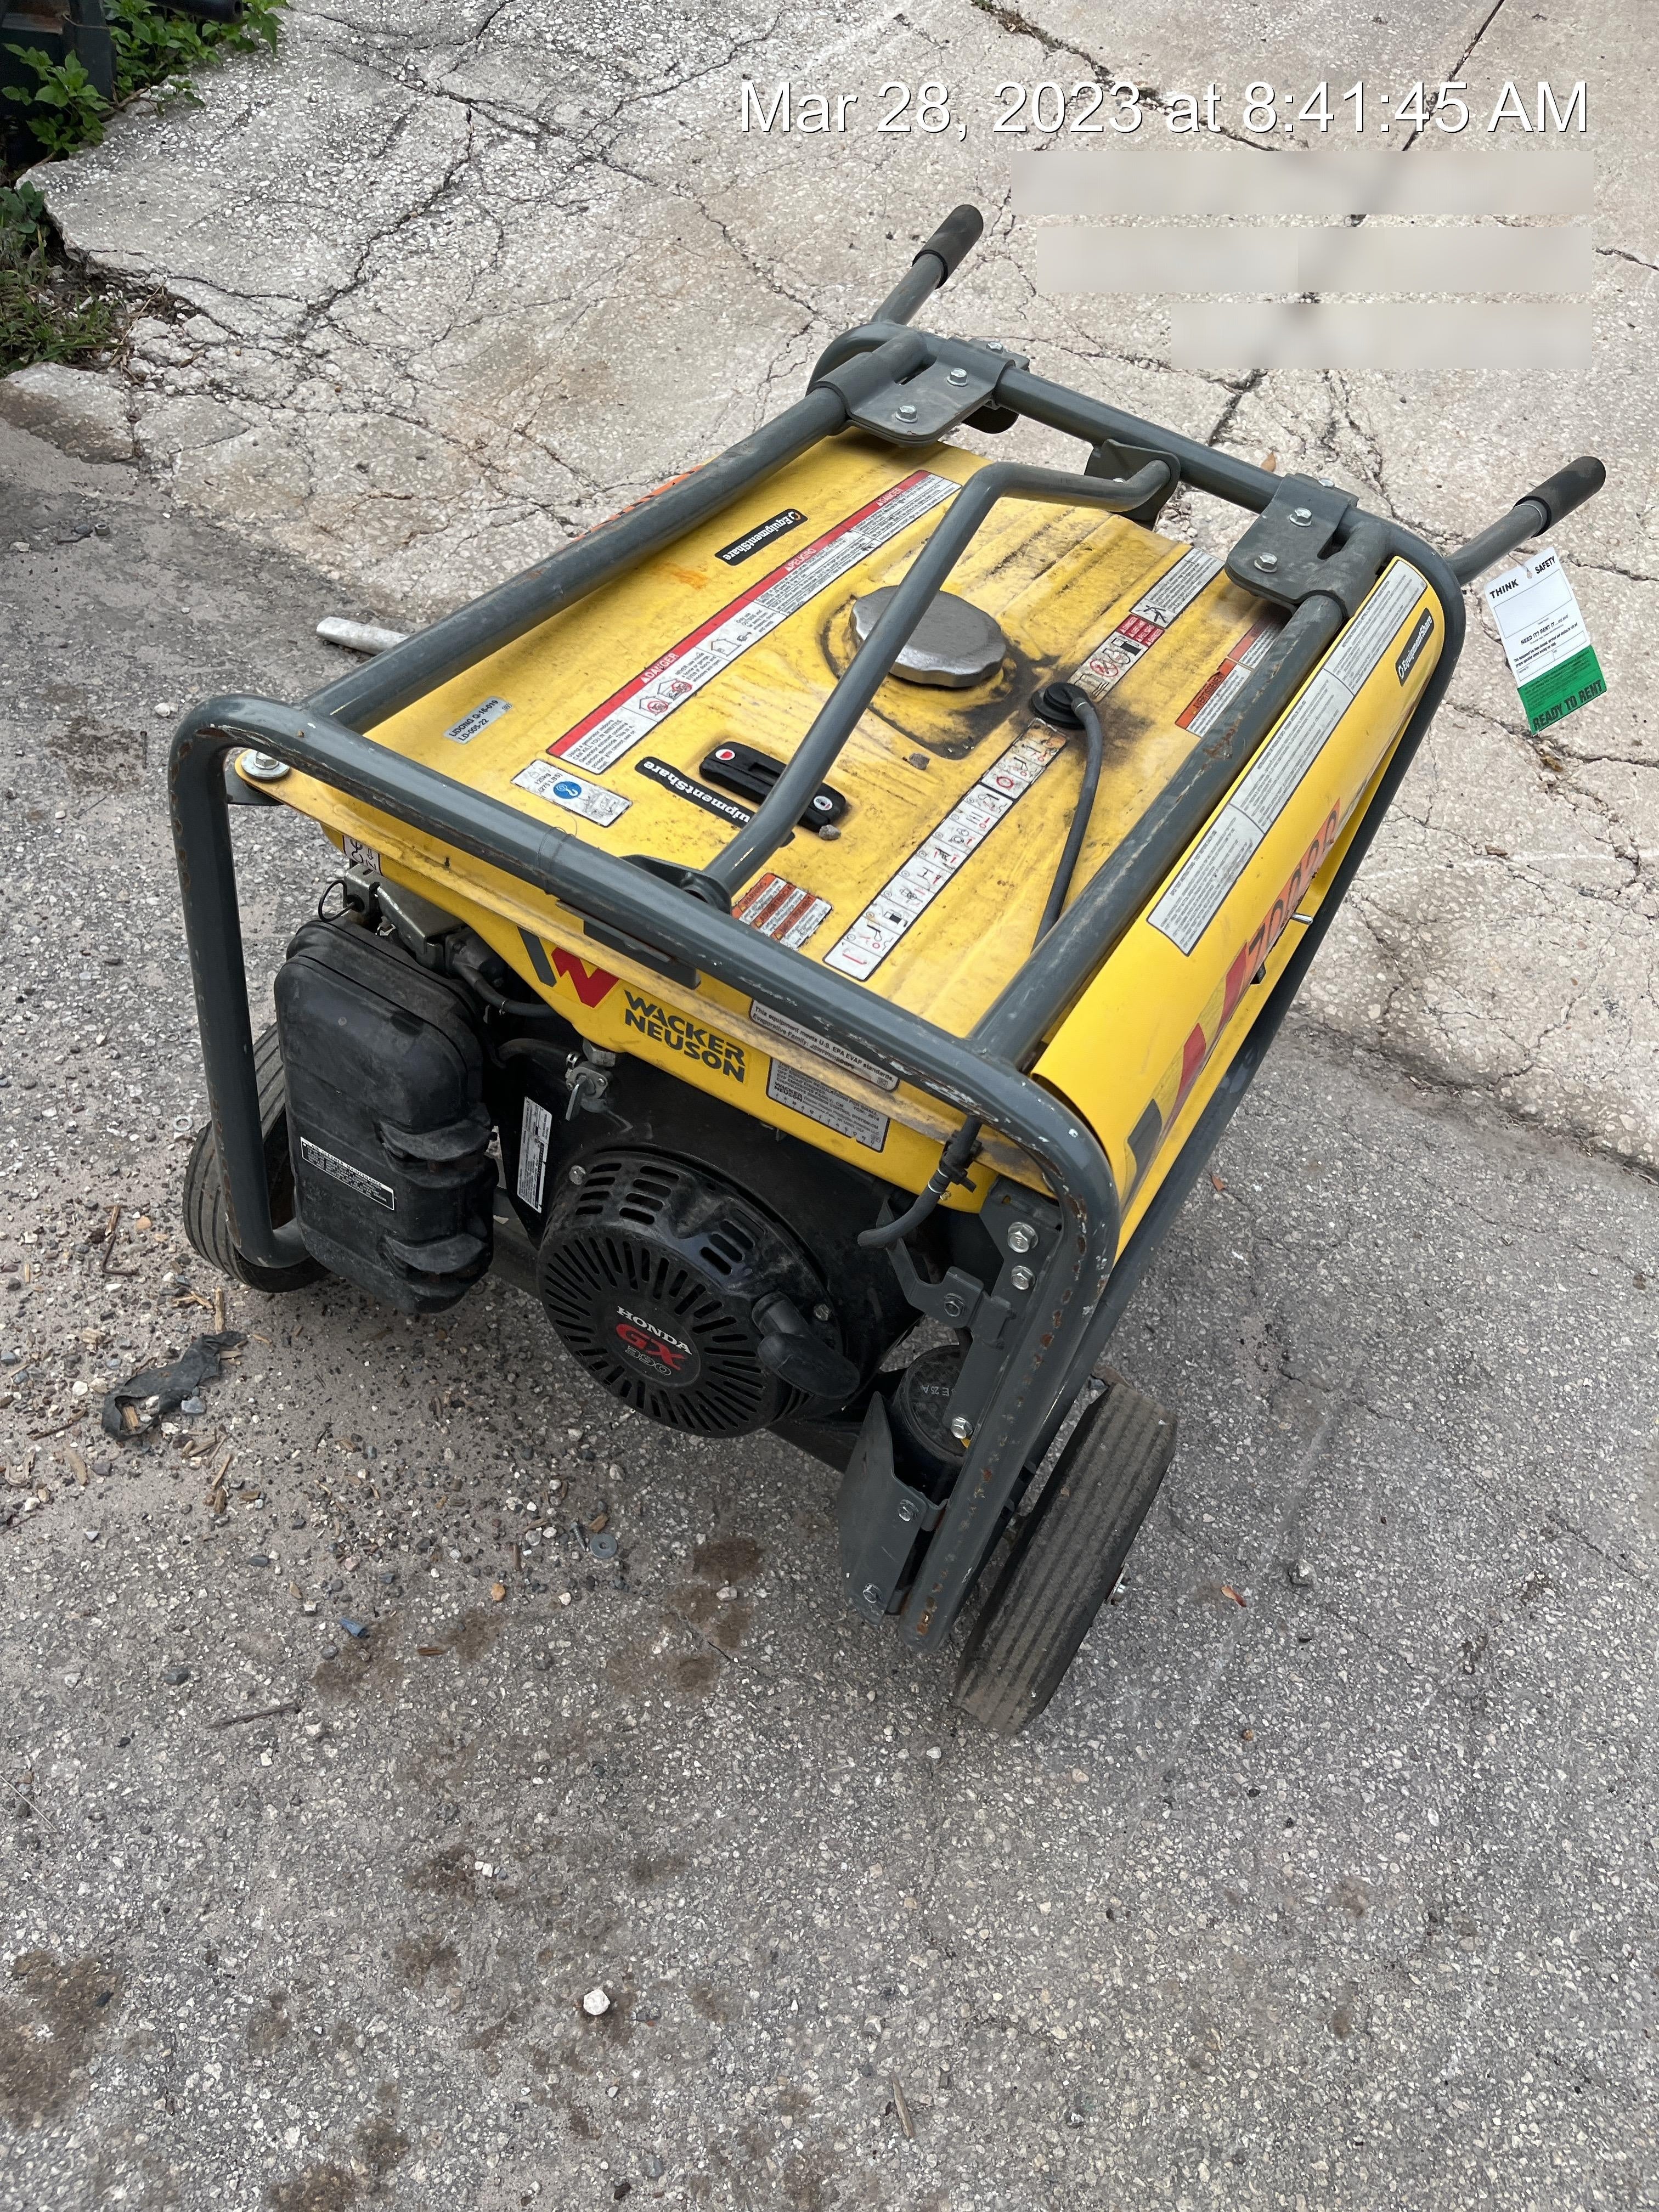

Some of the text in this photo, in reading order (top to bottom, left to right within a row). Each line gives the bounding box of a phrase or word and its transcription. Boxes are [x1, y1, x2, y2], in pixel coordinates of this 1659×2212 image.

[723, 516, 794, 560] EquipmentShare
[1489, 556, 1555, 599] THINK SAFETY
[1402, 616, 1432, 672] EquipmentShare
[1521, 635, 1532, 645] NEED
[1540, 625, 1550, 633] RENT
[645, 653, 679, 681] DANGER
[1532, 703, 1564, 731] READY
[1564, 695, 1577, 711] TO
[1578, 679, 1603, 702] RENT
[567, 747, 580, 757] Using
[644, 760, 751, 823] uipmentShare
[624, 989, 746, 1066] WACKER
[625, 1008, 745, 1084] NEUSON
[753, 1013, 786, 1035] Evaporative
[755, 1006, 766, 1015] This
[769, 1013, 798, 1033] equipment
[800, 1030, 817, 1042] meets
[819, 1039, 831, 1049] U.S.
[832, 1046, 844, 1056] EPA
[846, 1053, 862, 1065] EVAP
[864, 1062, 894, 1082] standards.
[775, 1081, 802, 1098] WACKER
[775, 1085, 802, 1102] NEUSON
[616, 1323, 687, 1370] GX
[617, 1306, 692, 1355] HONDA
